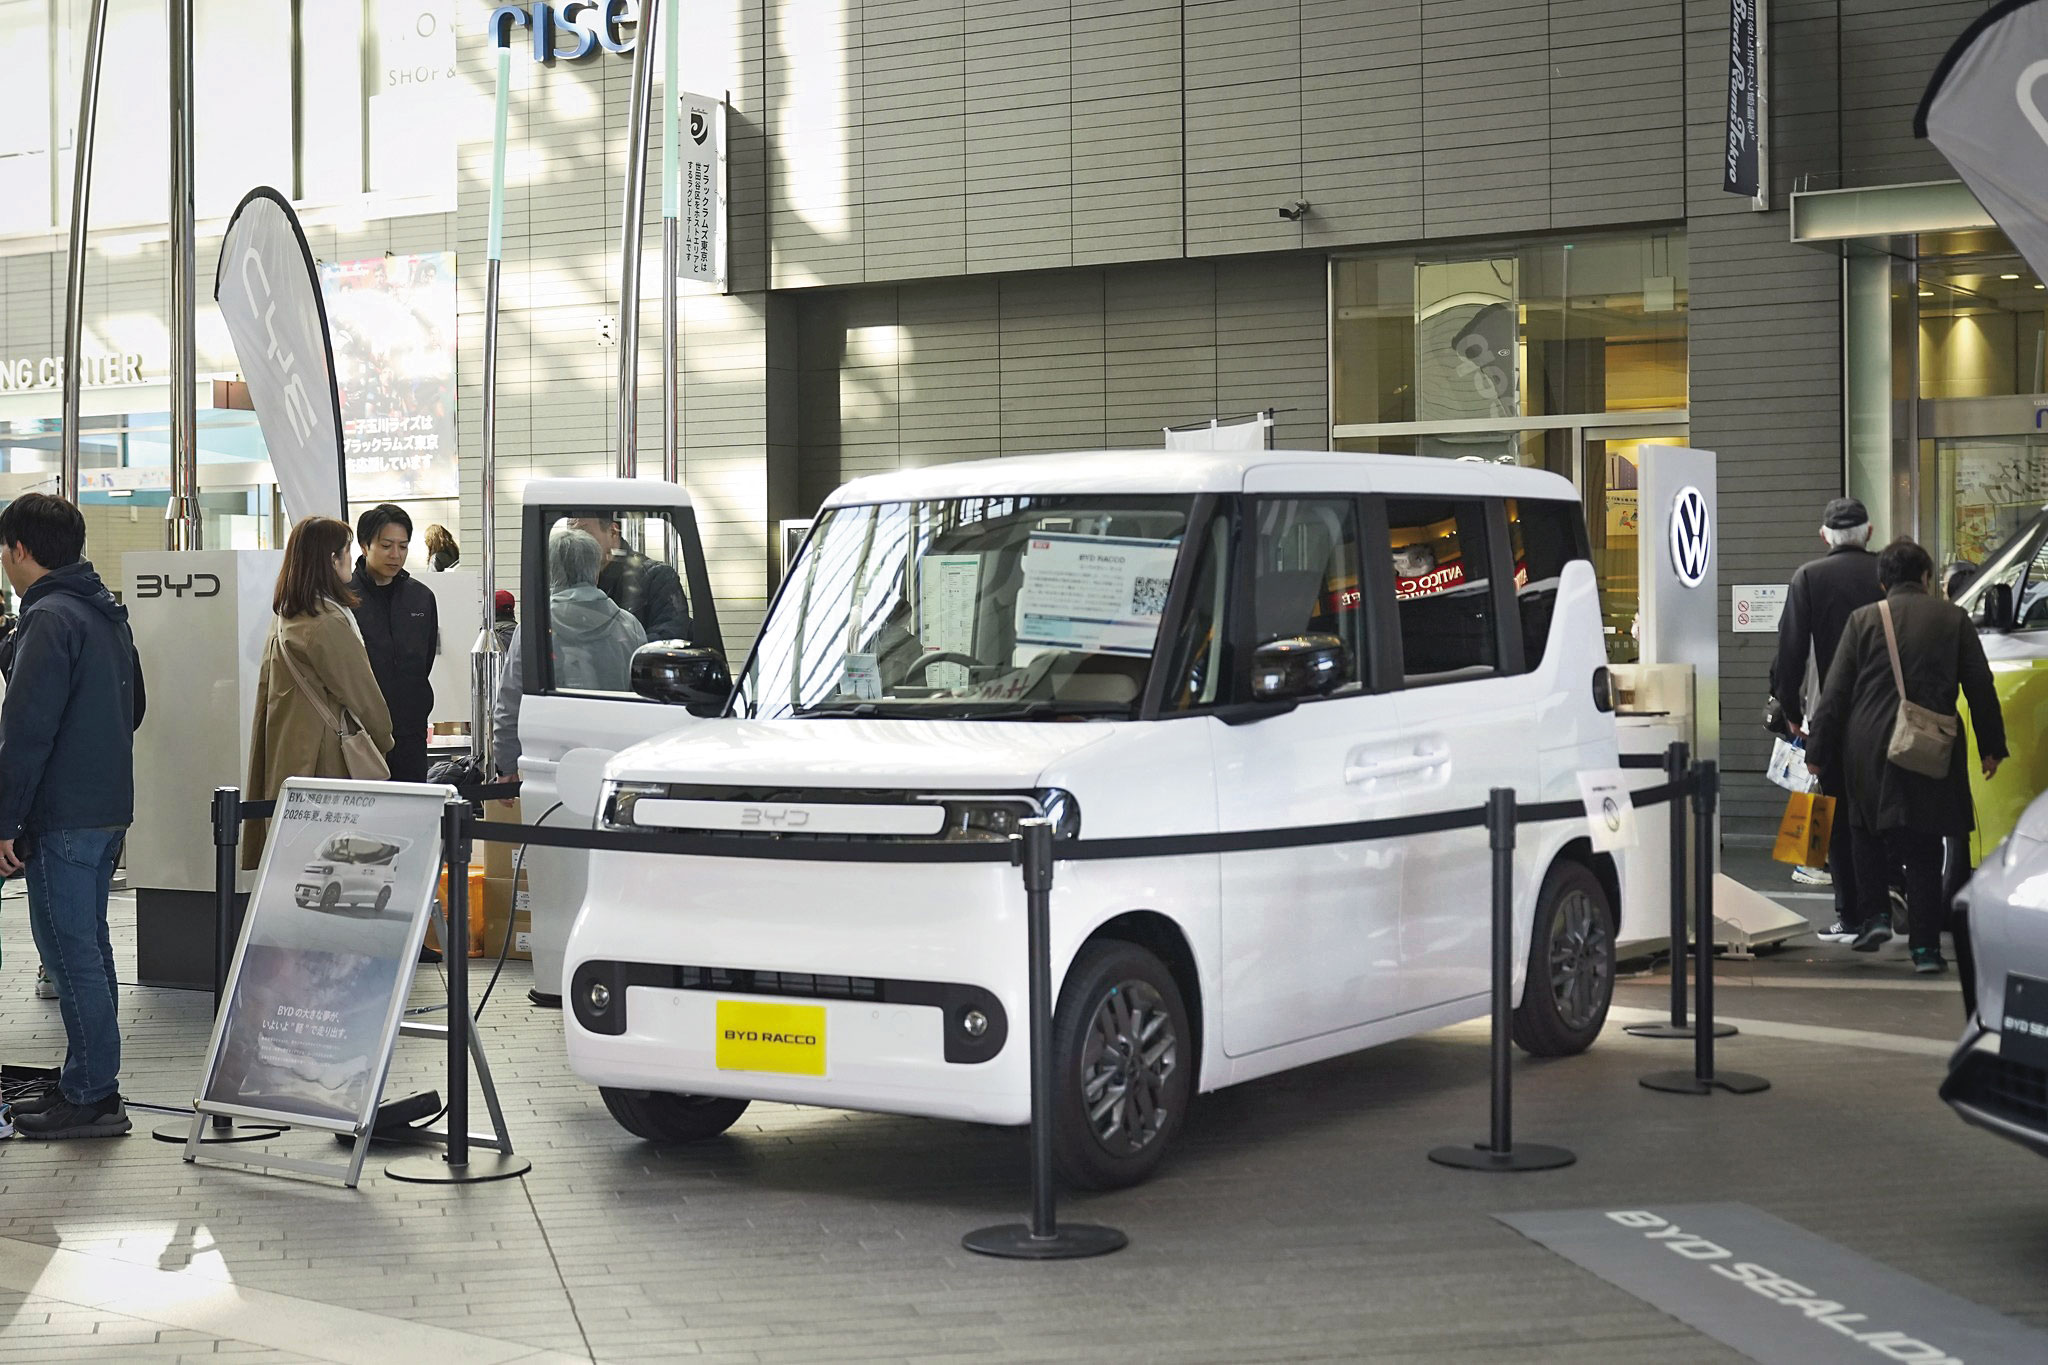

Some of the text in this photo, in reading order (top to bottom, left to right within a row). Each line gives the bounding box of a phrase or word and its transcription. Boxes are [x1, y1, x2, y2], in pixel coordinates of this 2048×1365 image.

[488, 0, 638, 62] rise
[1729, 117, 1746, 183] Tokyo
[693, 162, 702, 273] 世田谷区をホストエリアと
[700, 163, 710, 272] ブラックラムズ東京は
[343, 415, 433, 434] 二子玉川ライズは
[343, 434, 439, 454] ブラックラムズ東京
[137, 573, 221, 598] BYD
[342, 795, 376, 808] RACCO
[741, 808, 810, 827] BYD
[724, 1029, 817, 1046] BYD RACCO
[1605, 1210, 1733, 1260] BYD
